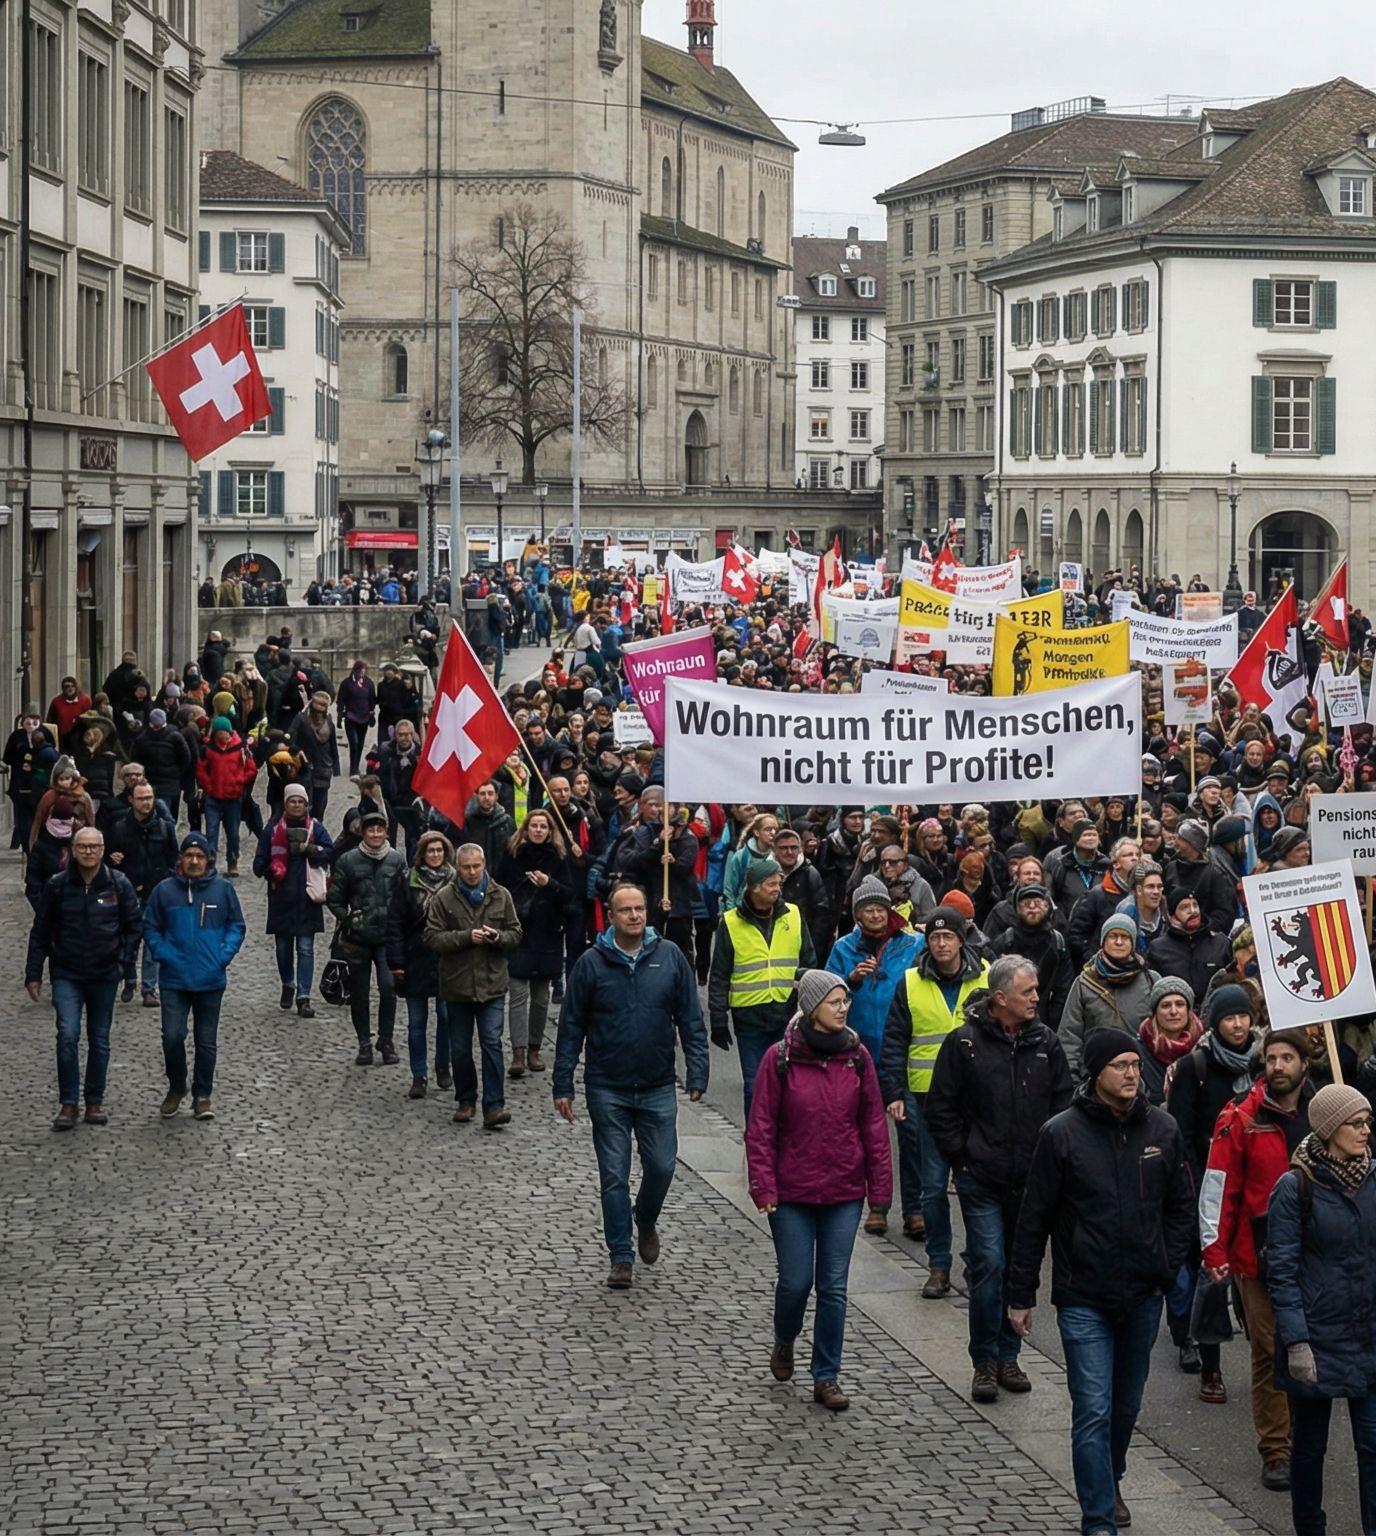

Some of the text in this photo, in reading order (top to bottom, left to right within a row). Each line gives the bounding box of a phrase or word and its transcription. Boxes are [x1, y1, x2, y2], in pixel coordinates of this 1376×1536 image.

[675, 700, 870, 740] Wohnraum
[881, 709, 933, 741] für
[945, 702, 1134, 741] Menschen,
[760, 745, 1054, 784] nicht für Profite!
[1343, 828, 1376, 840] nicht
